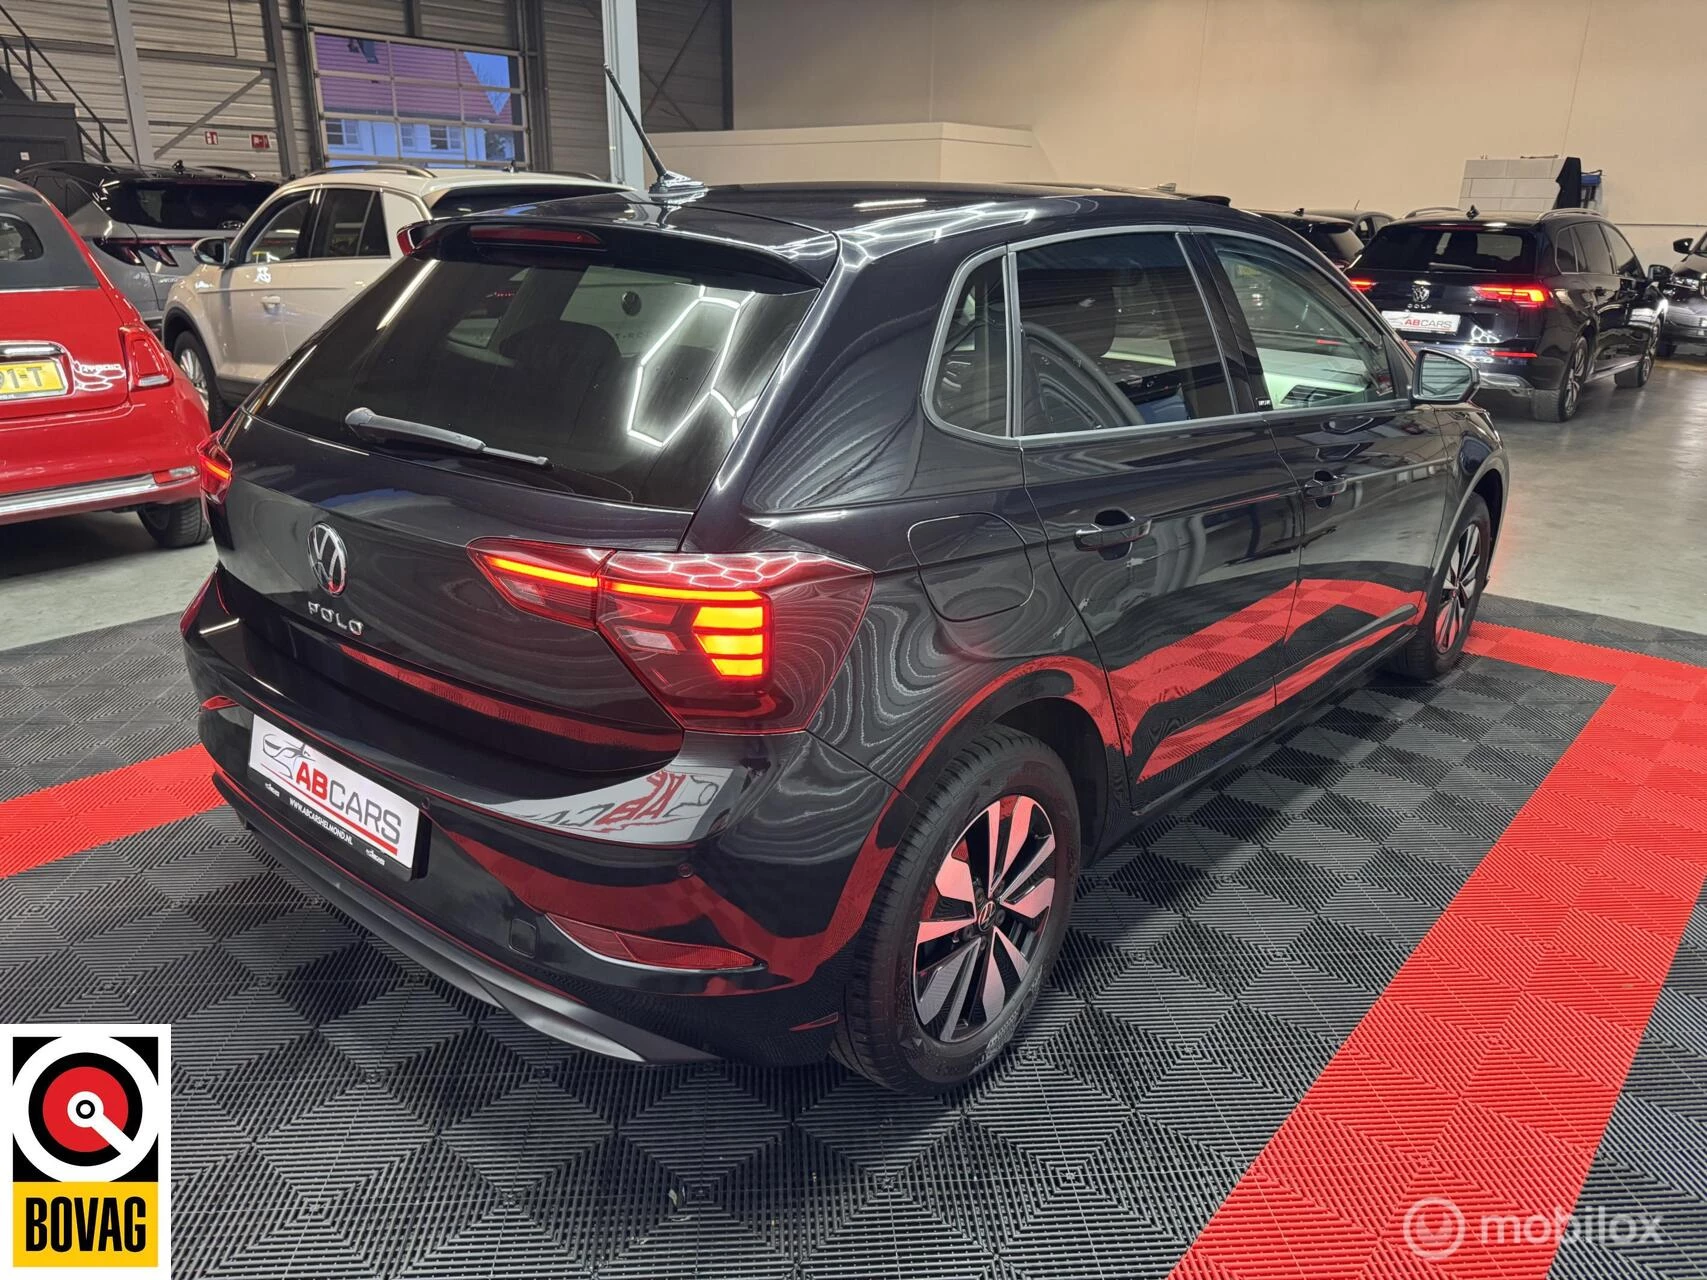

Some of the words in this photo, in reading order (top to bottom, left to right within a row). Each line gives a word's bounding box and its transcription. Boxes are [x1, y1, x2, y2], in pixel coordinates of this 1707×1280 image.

[1404, 319, 1453, 329] ABCARS
[308, 601, 364, 635] POLO
[296, 761, 401, 845] ABCARS
